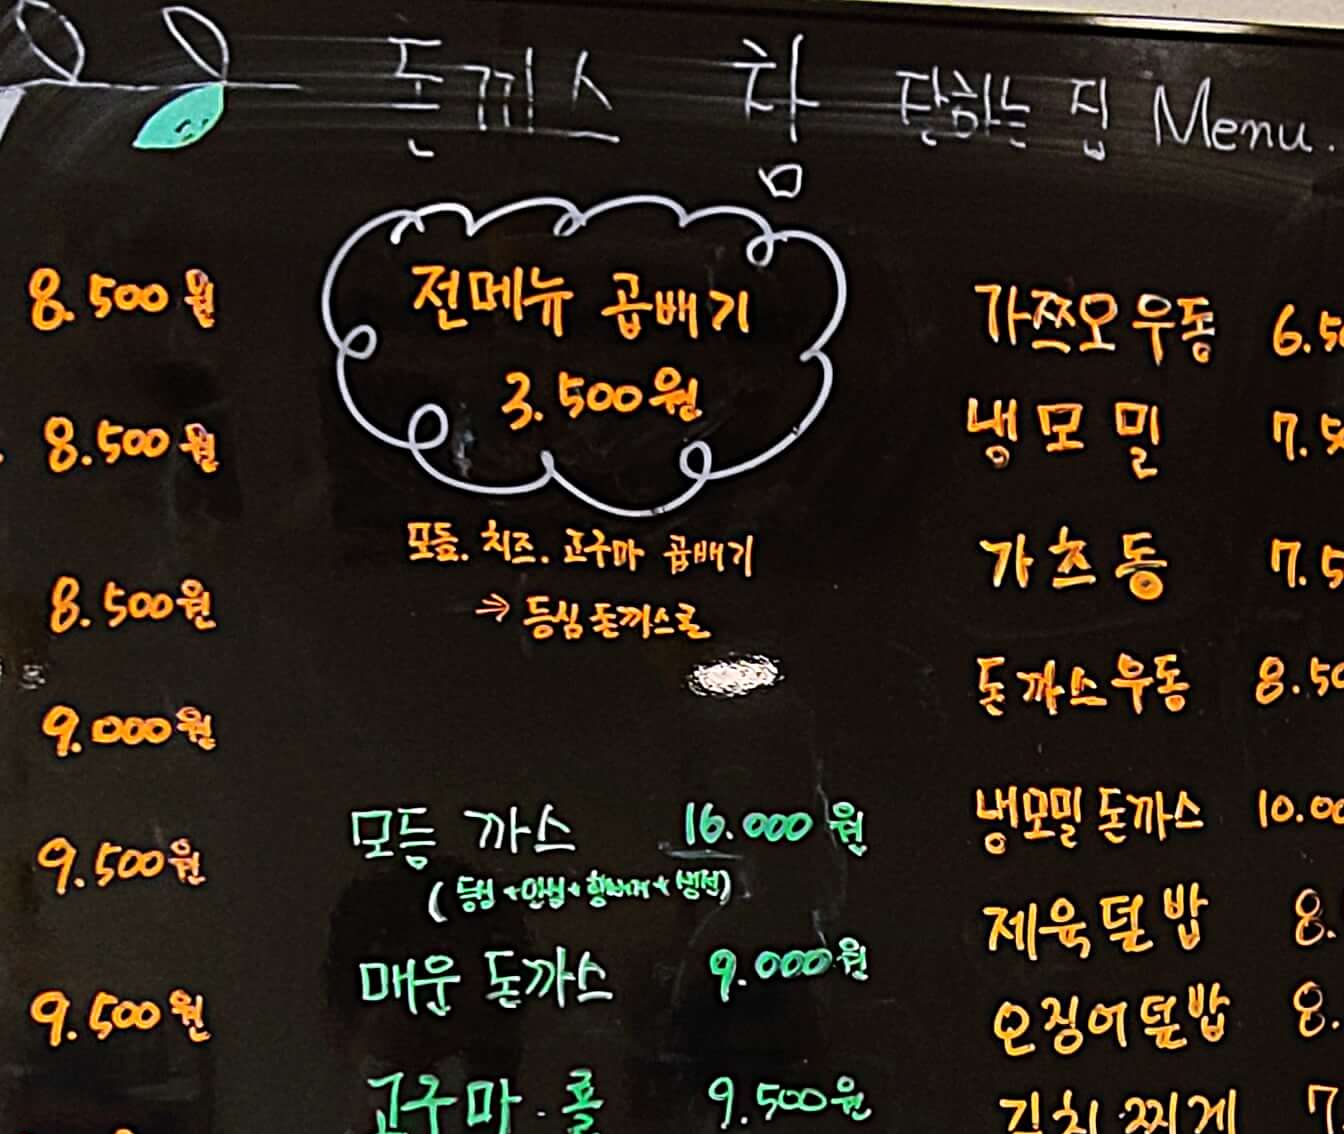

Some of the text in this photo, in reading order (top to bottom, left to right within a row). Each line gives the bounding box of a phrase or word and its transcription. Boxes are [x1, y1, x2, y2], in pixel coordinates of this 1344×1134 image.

[410, 264, 750, 341] 전메뉴 곱배기
[562, 526, 646, 573] 고구마
[662, 533, 755, 578] 곱배기
[358, 954, 462, 1018] 매운
[483, 945, 614, 1010] 돈까스
